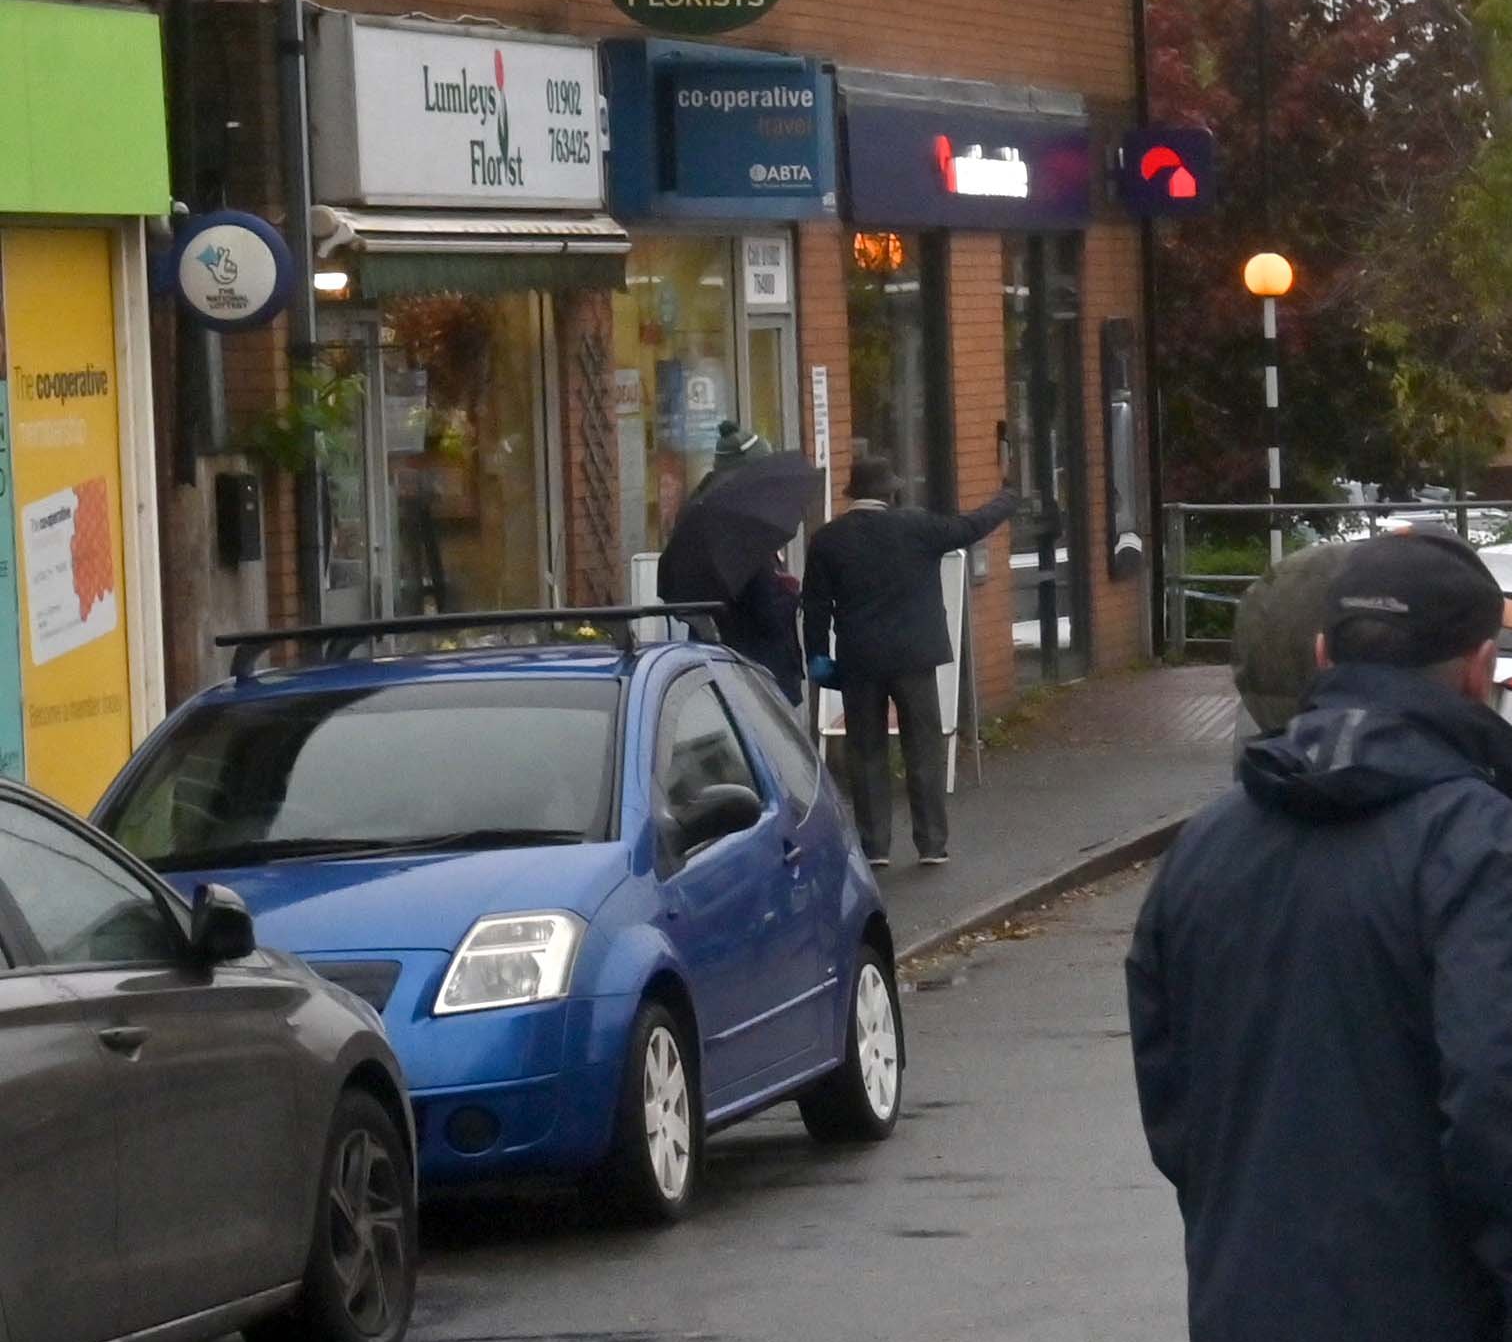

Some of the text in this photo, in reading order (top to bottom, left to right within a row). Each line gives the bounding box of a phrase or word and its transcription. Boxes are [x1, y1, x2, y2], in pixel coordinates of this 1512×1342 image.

[423, 65, 497, 126] Lumleys
[546, 78, 582, 116] 01902
[470, 140, 524, 186] Florist
[548, 127, 591, 165] 763425
[767, 165, 812, 181] ABTA
